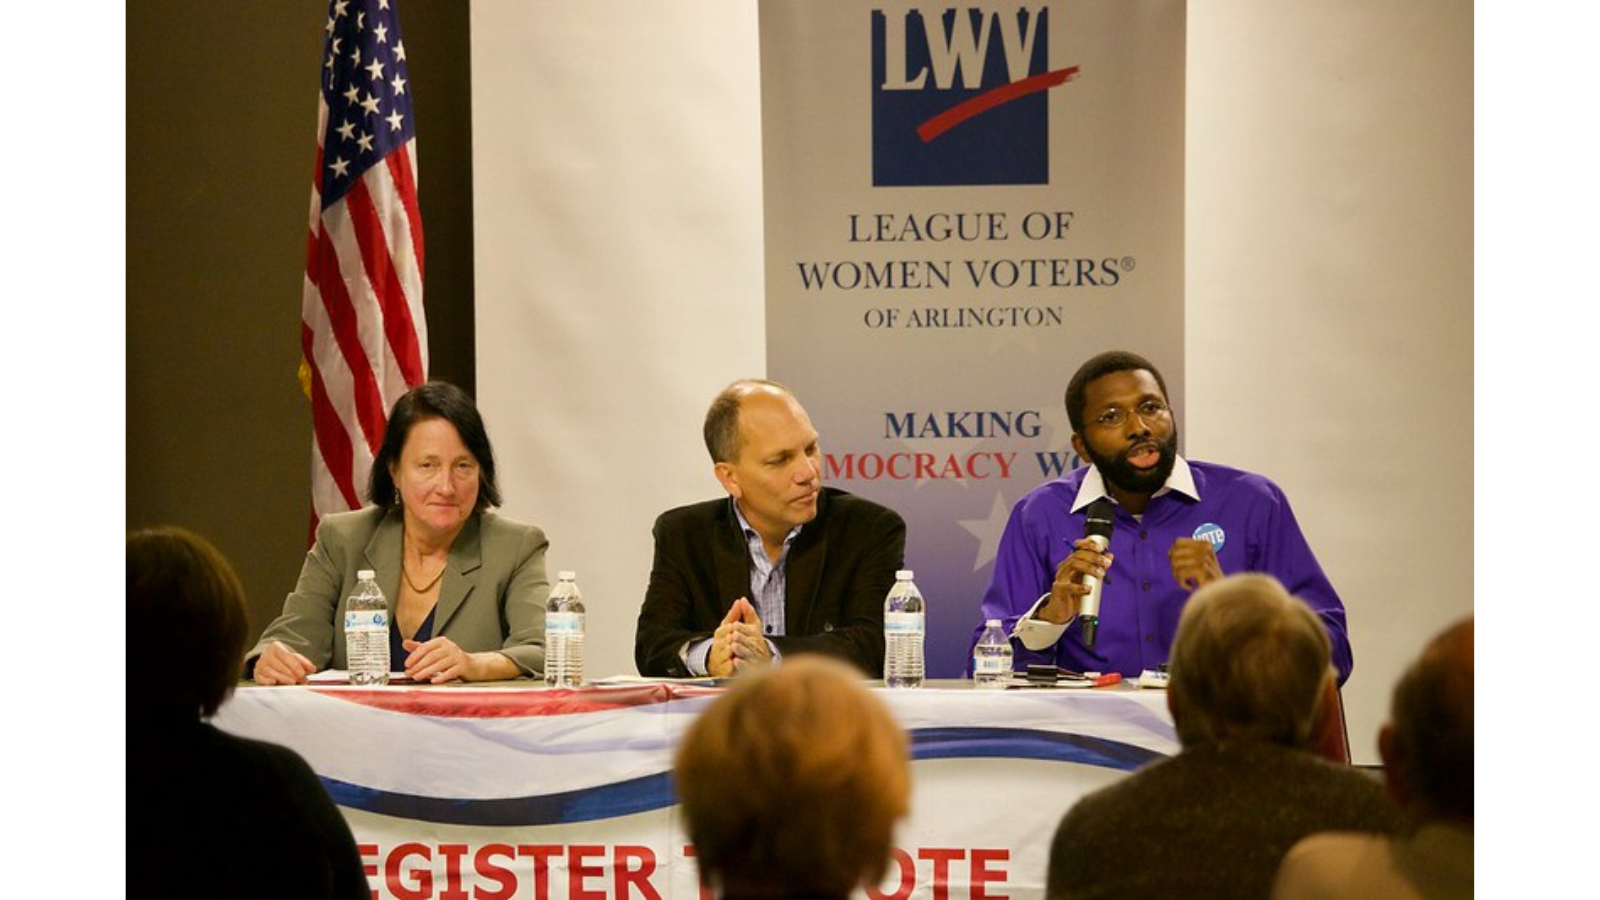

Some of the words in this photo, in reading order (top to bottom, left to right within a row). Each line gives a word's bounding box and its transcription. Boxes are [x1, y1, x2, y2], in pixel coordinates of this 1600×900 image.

[881, 8, 1046, 90] LWV
[848, 212, 1009, 242] LEAGUE
[1021, 211, 1075, 241] OF
[796, 260, 952, 290] WOMEN
[863, 308, 900, 329] OF
[905, 306, 1063, 329] ARLINGTON
[884, 410, 1042, 438] MAKING
[823, 451, 1018, 480] MOCRACY
[356, 842, 663, 900] EGISTER
[863, 847, 1010, 900] OTE
